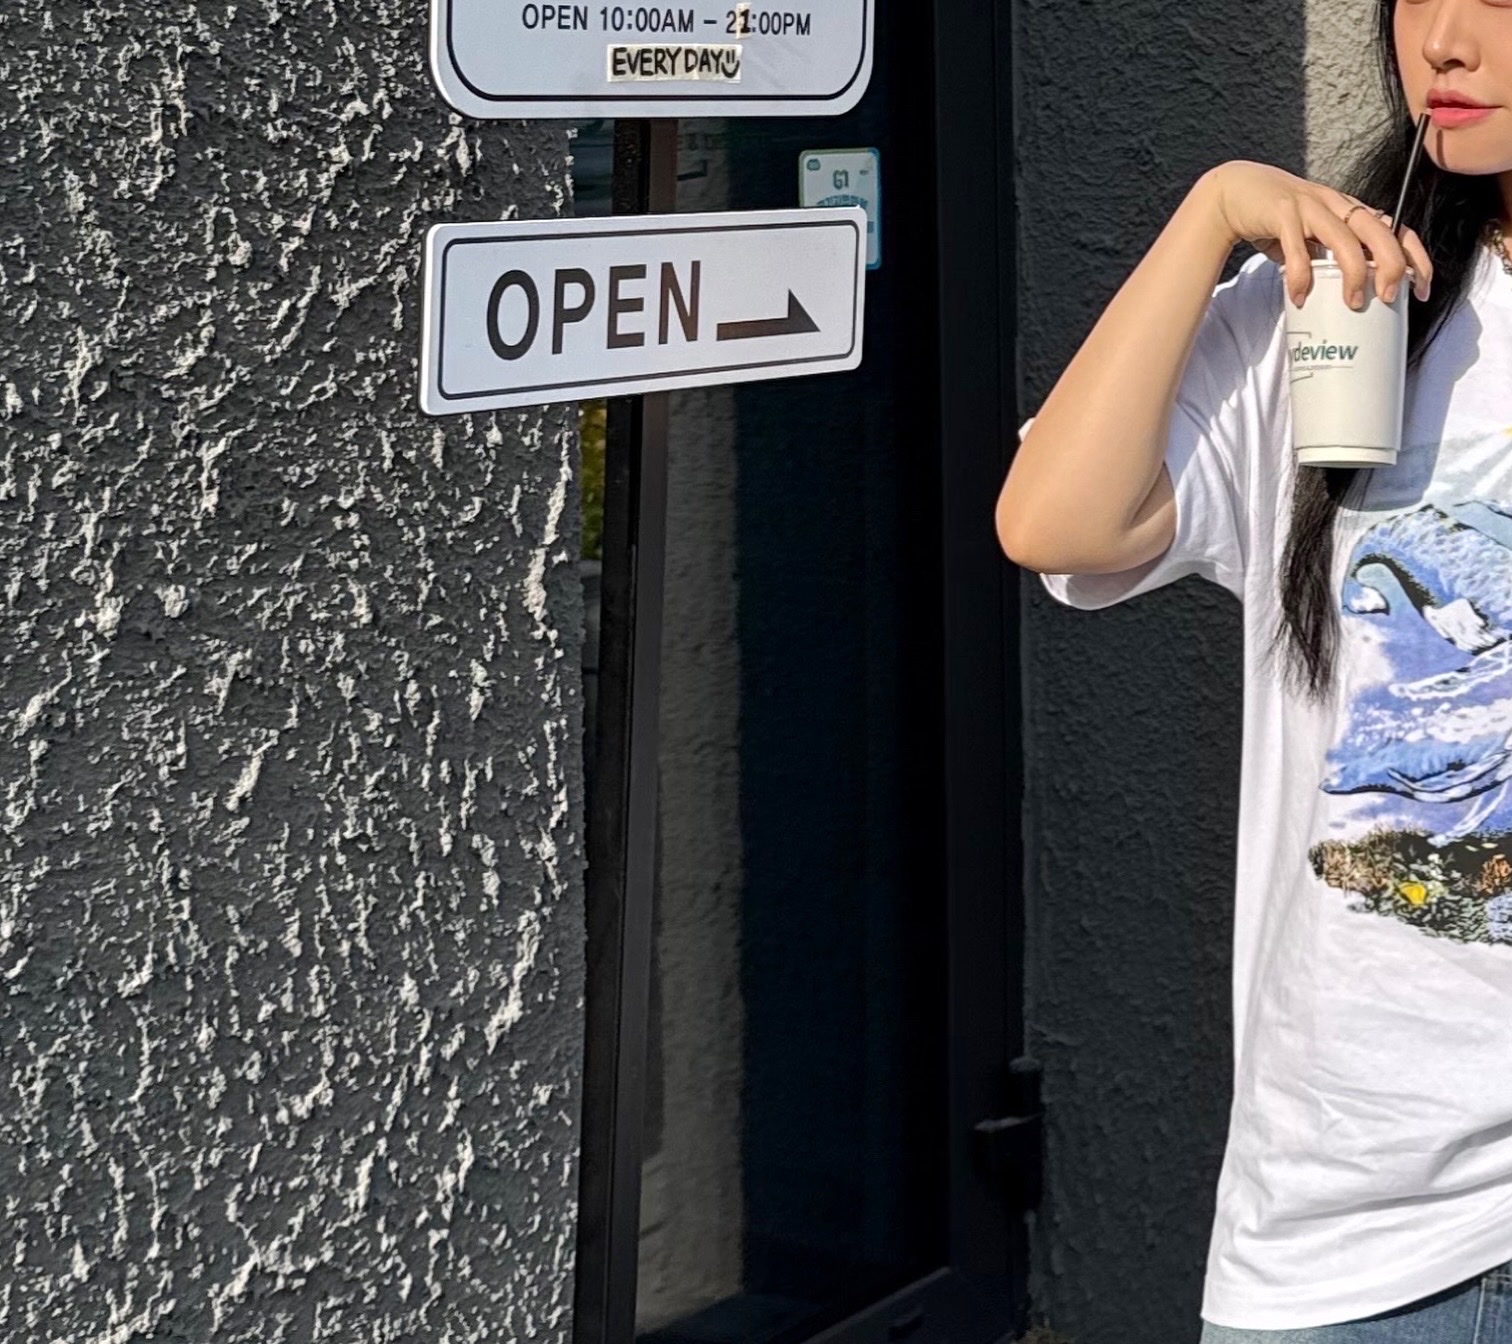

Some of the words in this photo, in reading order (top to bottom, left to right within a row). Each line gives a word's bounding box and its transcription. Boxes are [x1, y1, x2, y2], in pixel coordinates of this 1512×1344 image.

[521, 3, 589, 31] OPEN
[600, 6, 695, 34] 10:00AM
[725, 8, 811, 36] 21:00PM
[486, 259, 702, 361] OPEN
